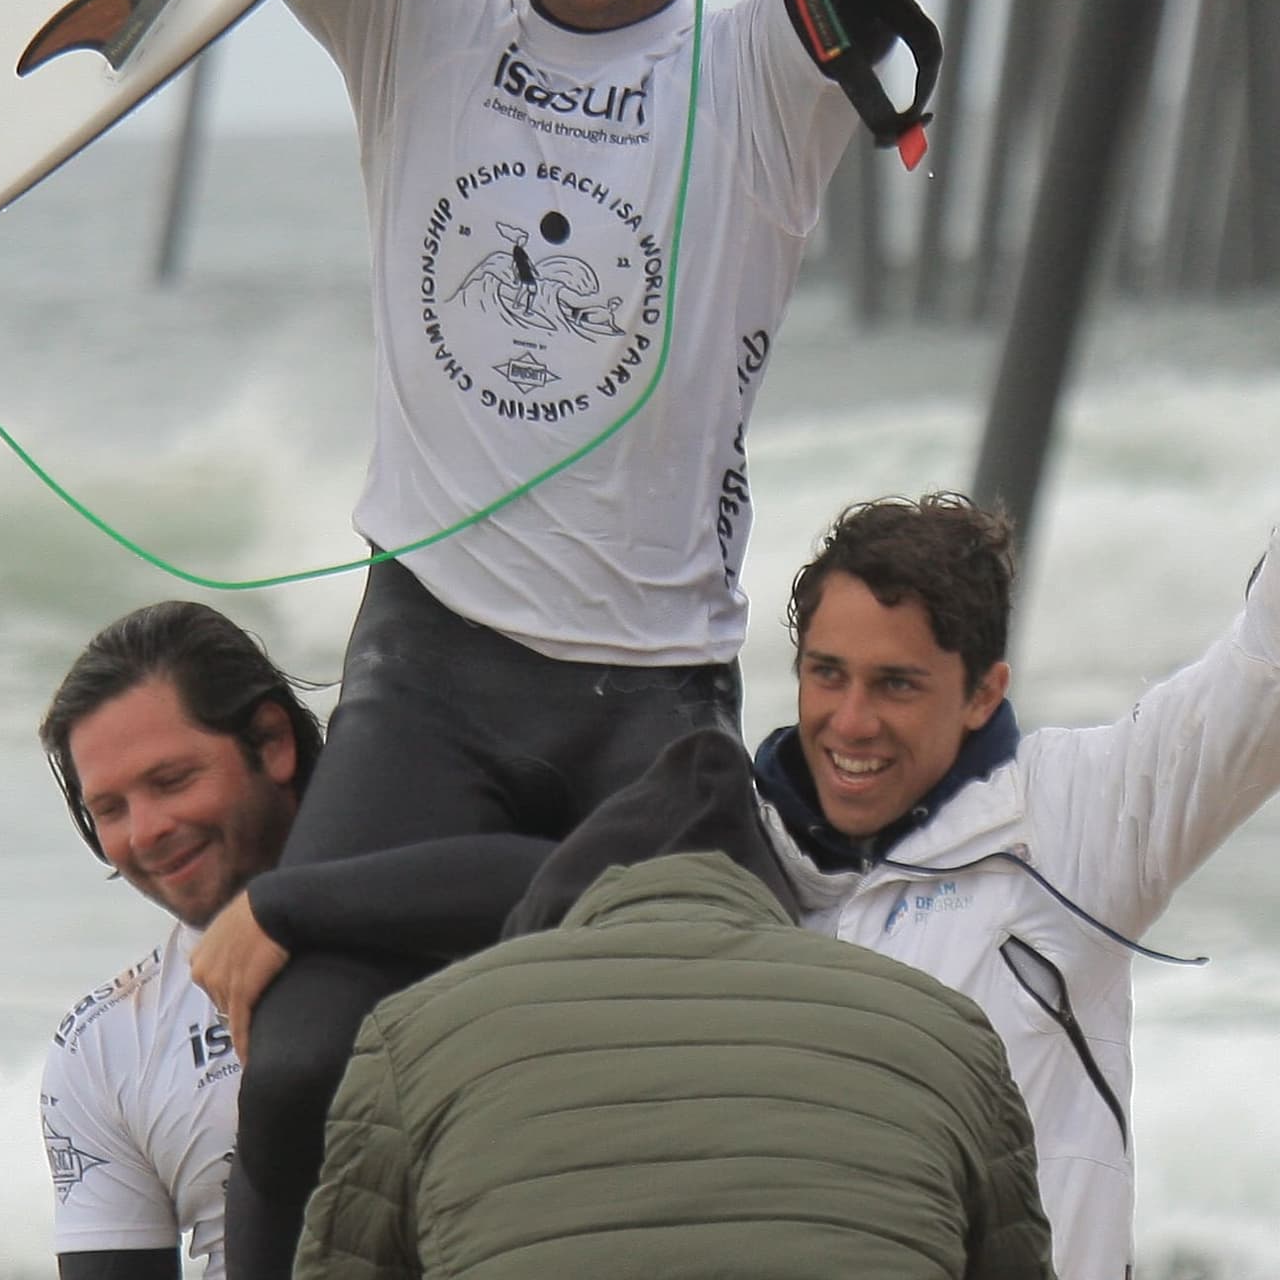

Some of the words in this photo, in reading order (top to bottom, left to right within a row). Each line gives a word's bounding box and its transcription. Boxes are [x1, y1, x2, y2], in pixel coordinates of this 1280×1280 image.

[555, 124, 607, 144] through
[456, 161, 526, 199] PISMO
[536, 163, 610, 204] BEACH
[609, 198, 643, 233] ISA
[421, 197, 473, 392] CHAMPIONSHIP
[640, 234, 663, 325] WORLD
[596, 333, 651, 397] PARA
[480, 389, 590, 422] SURFING
[205, 1063, 241, 1083] bette
